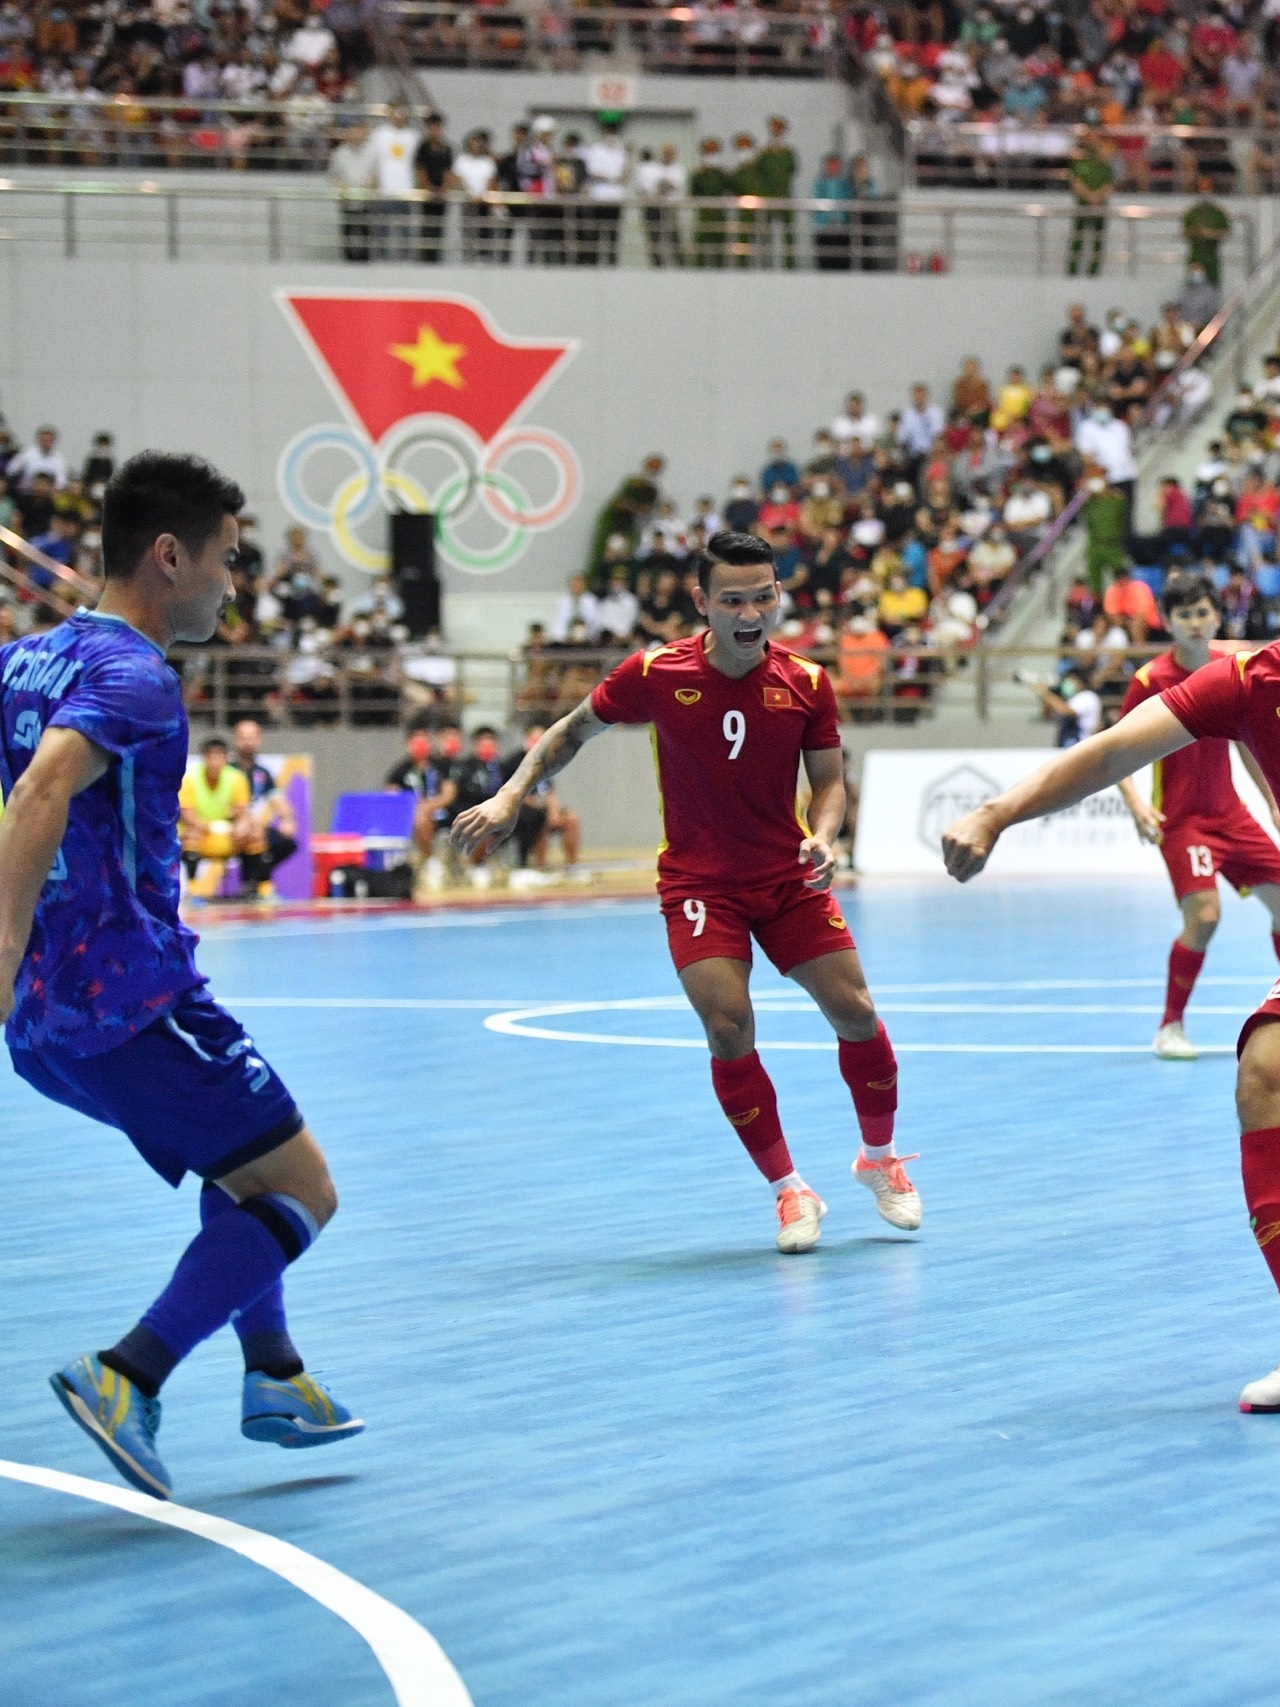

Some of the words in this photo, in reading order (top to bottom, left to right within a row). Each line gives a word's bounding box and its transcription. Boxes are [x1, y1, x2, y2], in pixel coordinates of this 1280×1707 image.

[722, 710, 746, 760] 9
[1186, 845, 1214, 877] 13
[683, 899, 706, 937] 9
